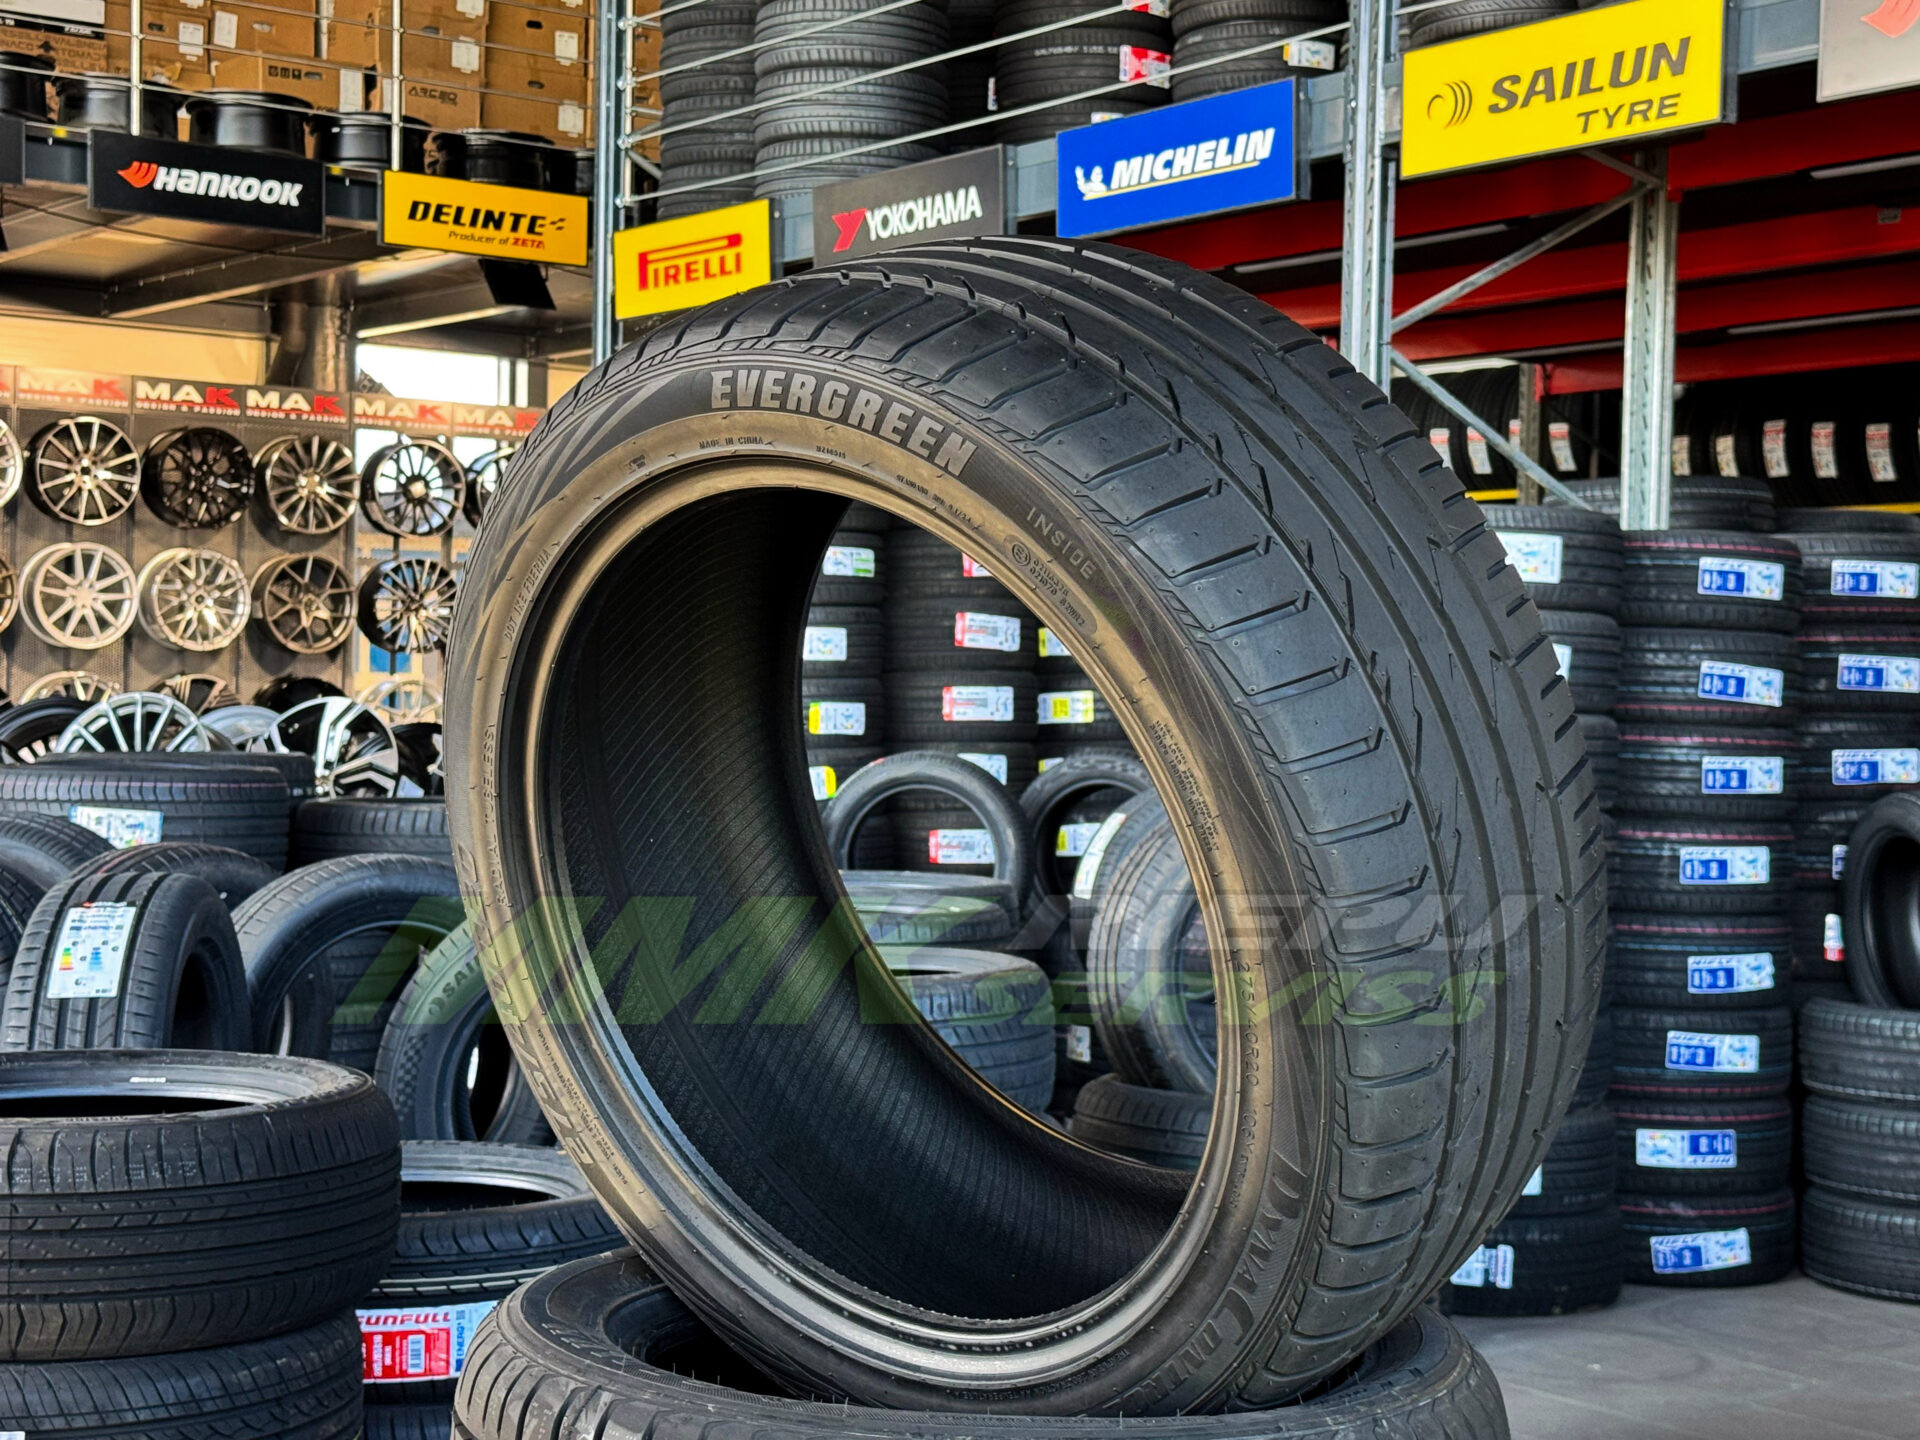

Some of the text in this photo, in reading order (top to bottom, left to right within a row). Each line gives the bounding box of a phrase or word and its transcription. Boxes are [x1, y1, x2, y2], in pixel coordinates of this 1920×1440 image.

[1487, 36, 1691, 115] SAILUN
[1576, 93, 1682, 134] TYRE
[1111, 127, 1274, 188] MICHELIN
[407, 200, 547, 236] DELINTE
[864, 185, 983, 243] YOKOHAMA
[448, 230, 545, 249] Producer of ZETA
[638, 233, 743, 290] PIRELLI
[20, 372, 126, 398] MAK
[136, 381, 239, 408] MAK
[247, 389, 345, 415] MAK
[354, 398, 448, 422] MAK
[455, 408, 539, 429] MAK
[710, 369, 978, 477] EVERGREEN
[699, 436, 764, 449] MADE IN CHINA
[1027, 507, 1097, 579] INSIDE
[482, 729, 495, 824] TUBELESS
[1236, 961, 1260, 1087] 275/40R20
